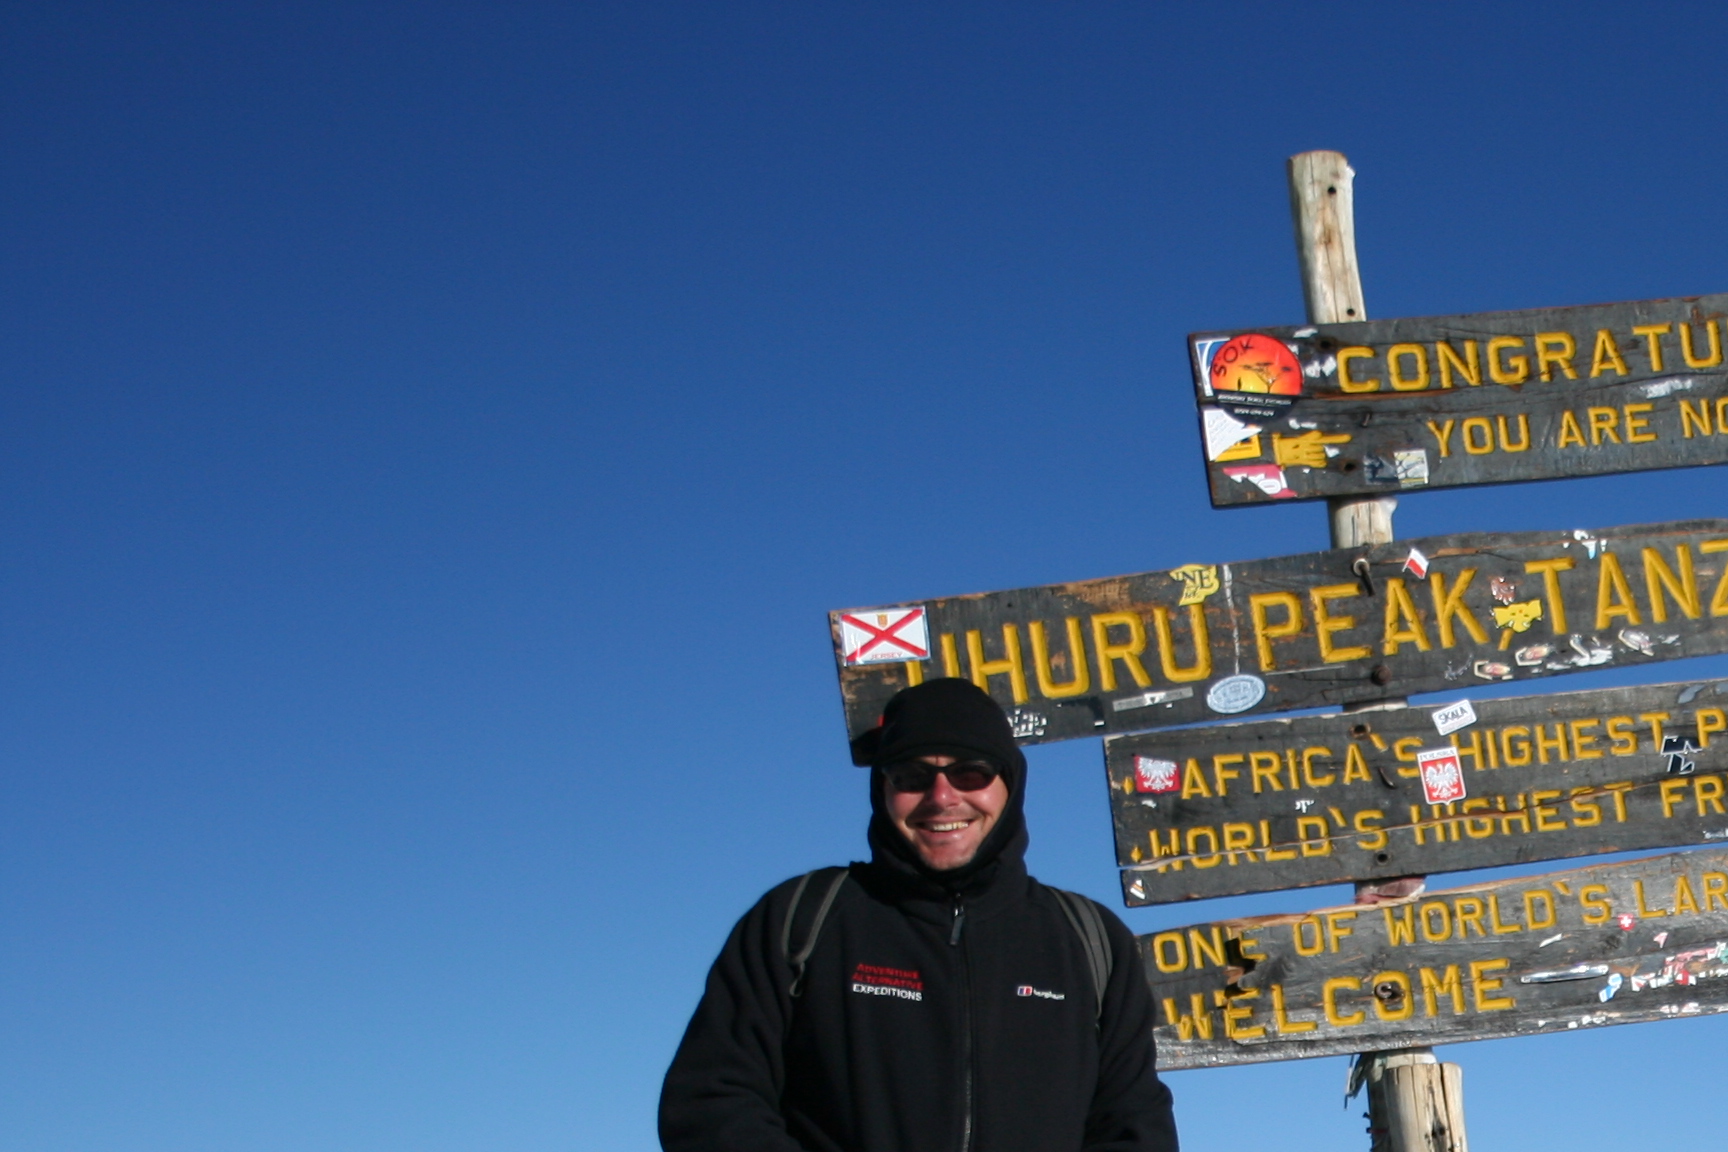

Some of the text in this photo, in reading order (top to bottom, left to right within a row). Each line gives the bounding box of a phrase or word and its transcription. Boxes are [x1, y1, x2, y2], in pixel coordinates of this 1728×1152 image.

[1427, 414, 1531, 457] YOU
[1558, 403, 1657, 448] ARE
[871, 652, 903, 661] JERSEY
[1180, 733, 1424, 801] AFRICA'S
[1449, 711, 1671, 772] HIGHEST
[1419, 749, 1455, 761] POLSKA
[1148, 806, 1388, 872] WORLD'S
[1409, 780, 1634, 846] HIGHEST
[1152, 925, 1267, 974] ONE
[1292, 910, 1358, 958] OF
[1383, 883, 1612, 947] WORLD'S
[852, 983, 923, 1002] EXPEDITIONS
[1163, 957, 1517, 1041] WELCOME
